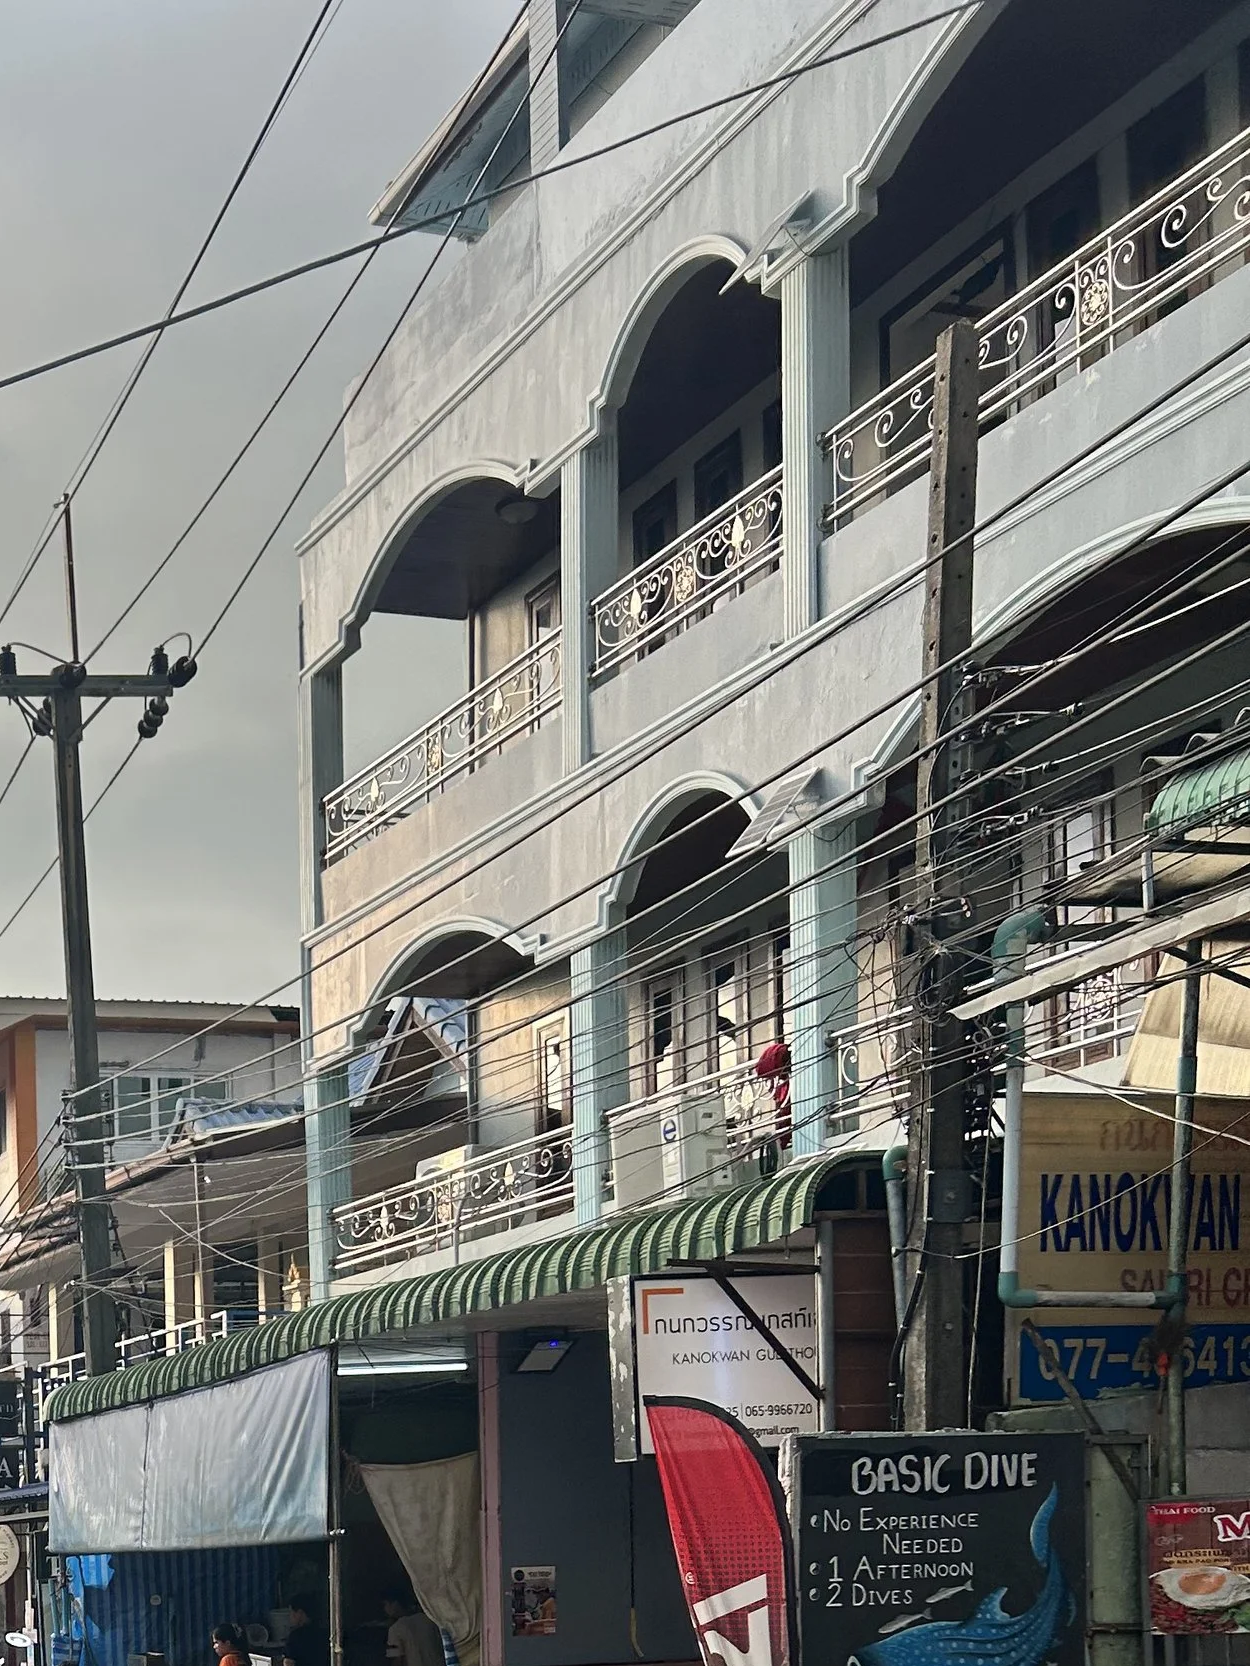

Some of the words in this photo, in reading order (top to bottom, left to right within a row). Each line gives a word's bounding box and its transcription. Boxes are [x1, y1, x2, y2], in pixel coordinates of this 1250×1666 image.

[672, 1350, 750, 1365] KANOKWAN
[745, 1404, 813, 1417] 065-9966720
[851, 1453, 950, 1495] BASIC
[964, 1453, 1038, 1489] DIVE
[1183, 1506, 1216, 1514] FOOD
[883, 1534, 963, 1554] NEEDED
[829, 1556, 843, 1582] 1
[853, 1555, 973, 1581] AFTERNOON
[826, 1583, 843, 1607] 2
[852, 1583, 913, 1606] DIVES
